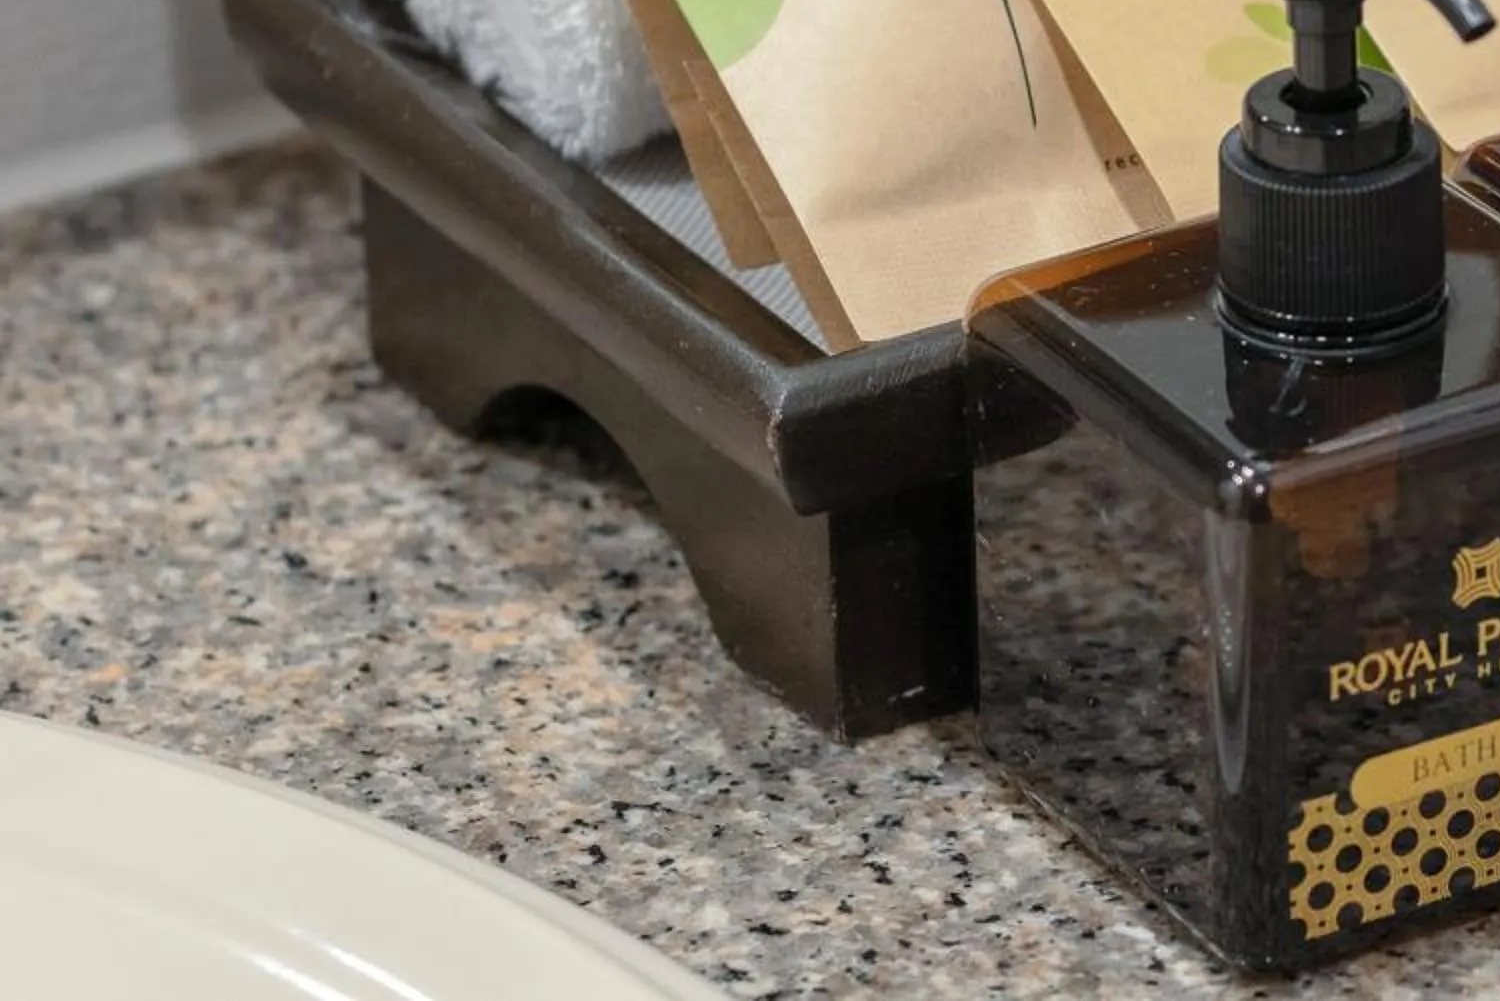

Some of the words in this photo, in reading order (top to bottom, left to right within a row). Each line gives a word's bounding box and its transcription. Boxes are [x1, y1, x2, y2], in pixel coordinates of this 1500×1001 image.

[1328, 632, 1463, 701] ROYAL
[1387, 673, 1457, 707] CITY
[1412, 735, 1497, 783] BATH
